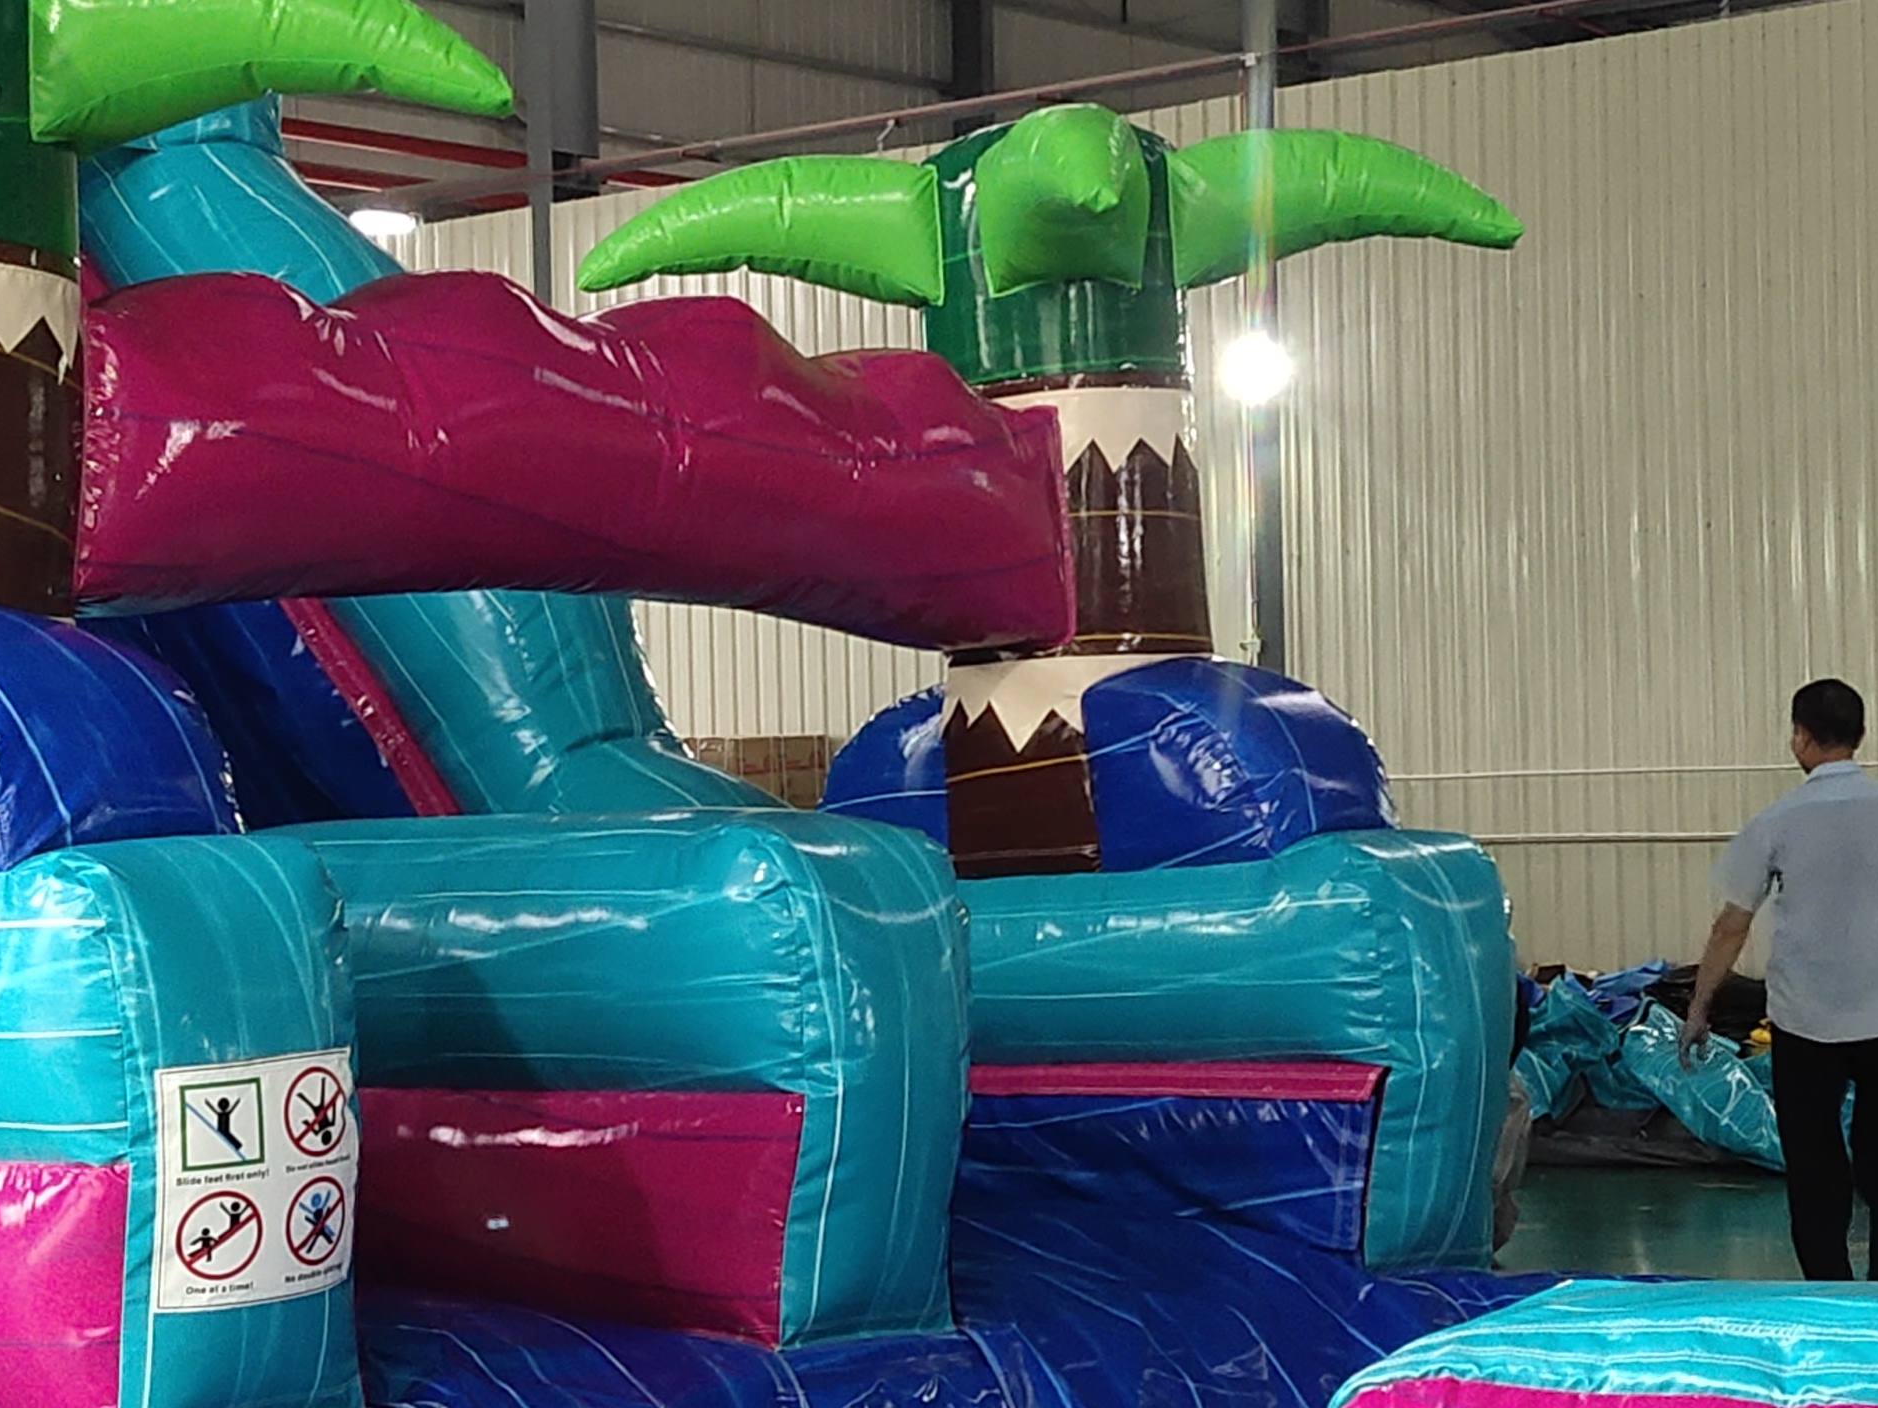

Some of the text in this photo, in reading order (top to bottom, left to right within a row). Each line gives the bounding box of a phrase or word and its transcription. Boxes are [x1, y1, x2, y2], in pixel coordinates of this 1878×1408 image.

[176, 1168, 270, 1186] Slide feet first only!
[185, 1286, 206, 1295] One
[209, 1285, 219, 1294] at
[229, 1281, 254, 1292] time!
